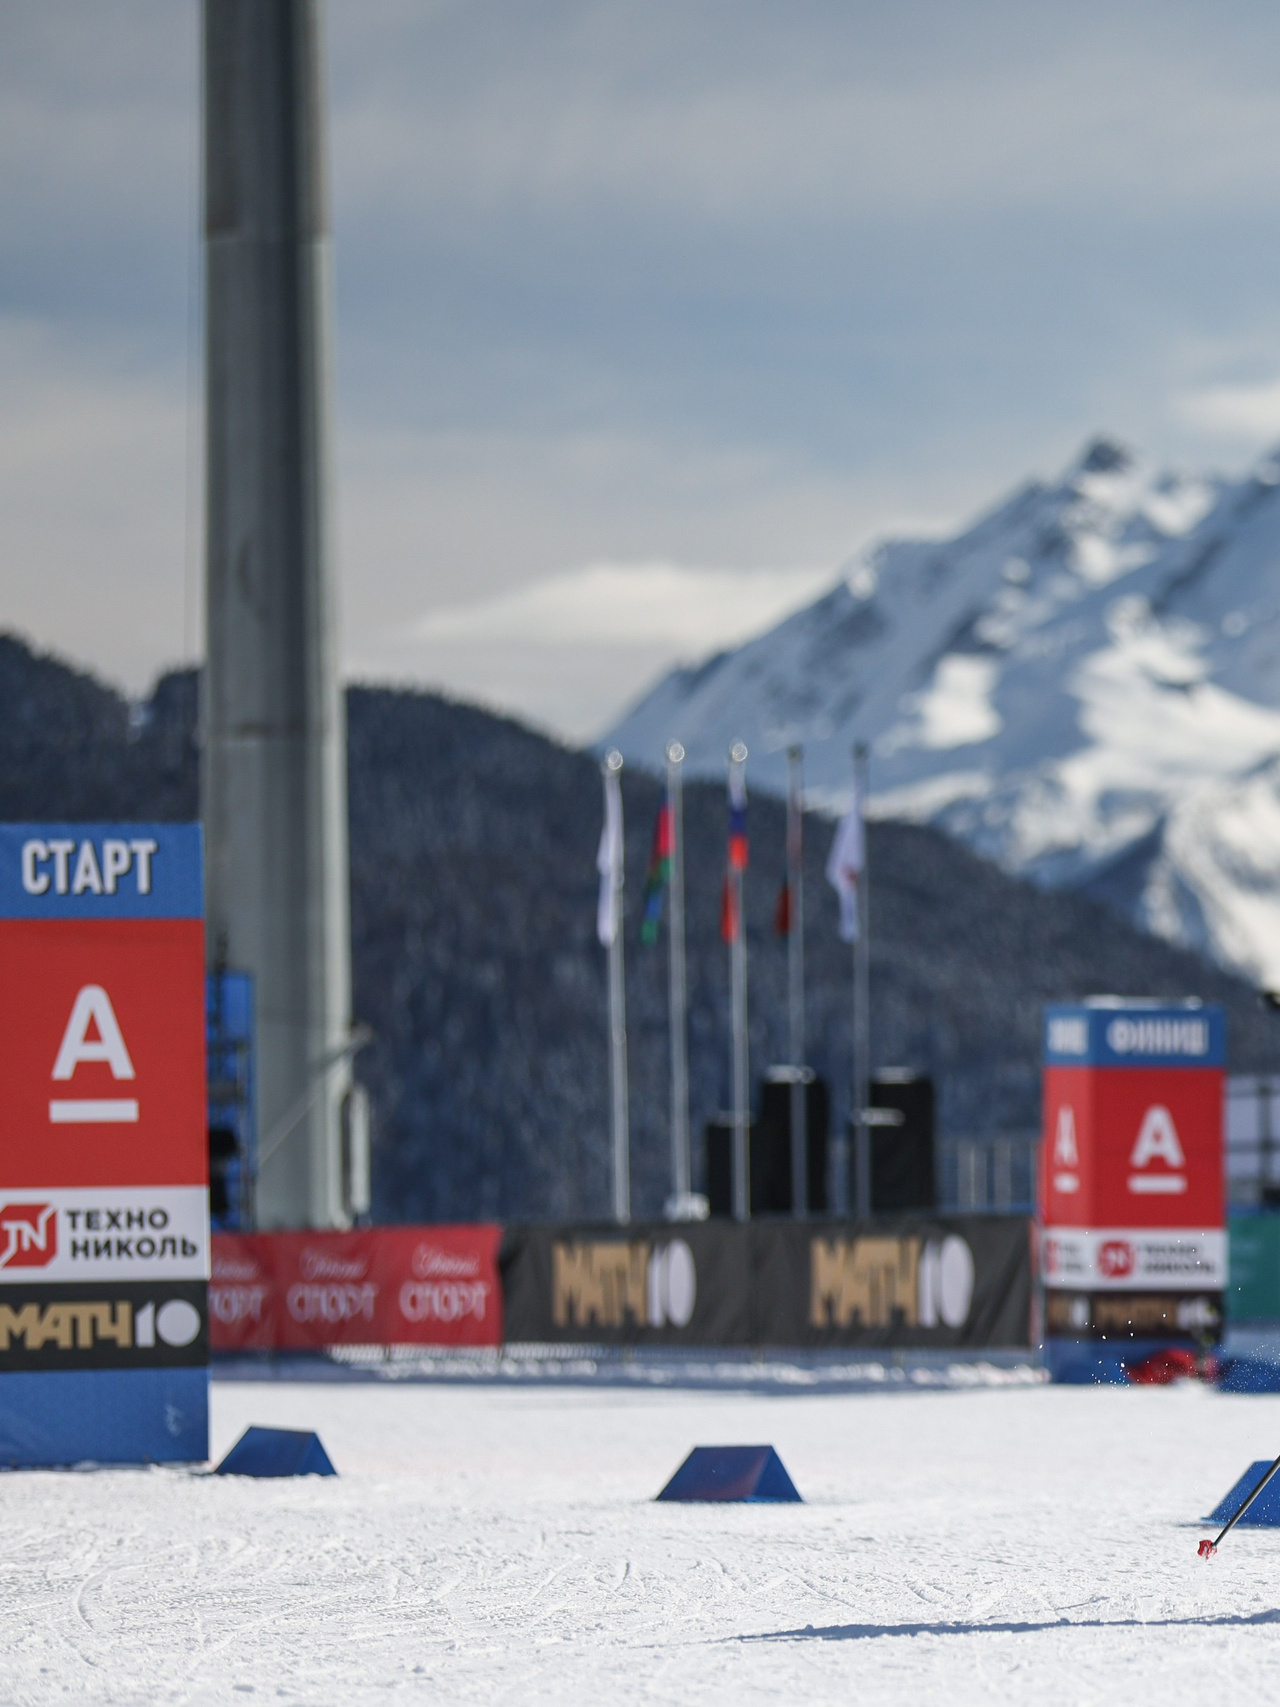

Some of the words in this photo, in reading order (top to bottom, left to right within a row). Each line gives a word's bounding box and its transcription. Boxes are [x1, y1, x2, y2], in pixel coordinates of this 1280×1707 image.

[21, 838, 158, 896] СТАРТ
[66, 1209, 169, 1232] ТЕХНО
[71, 1236, 199, 1260] НИКОЛЬ
